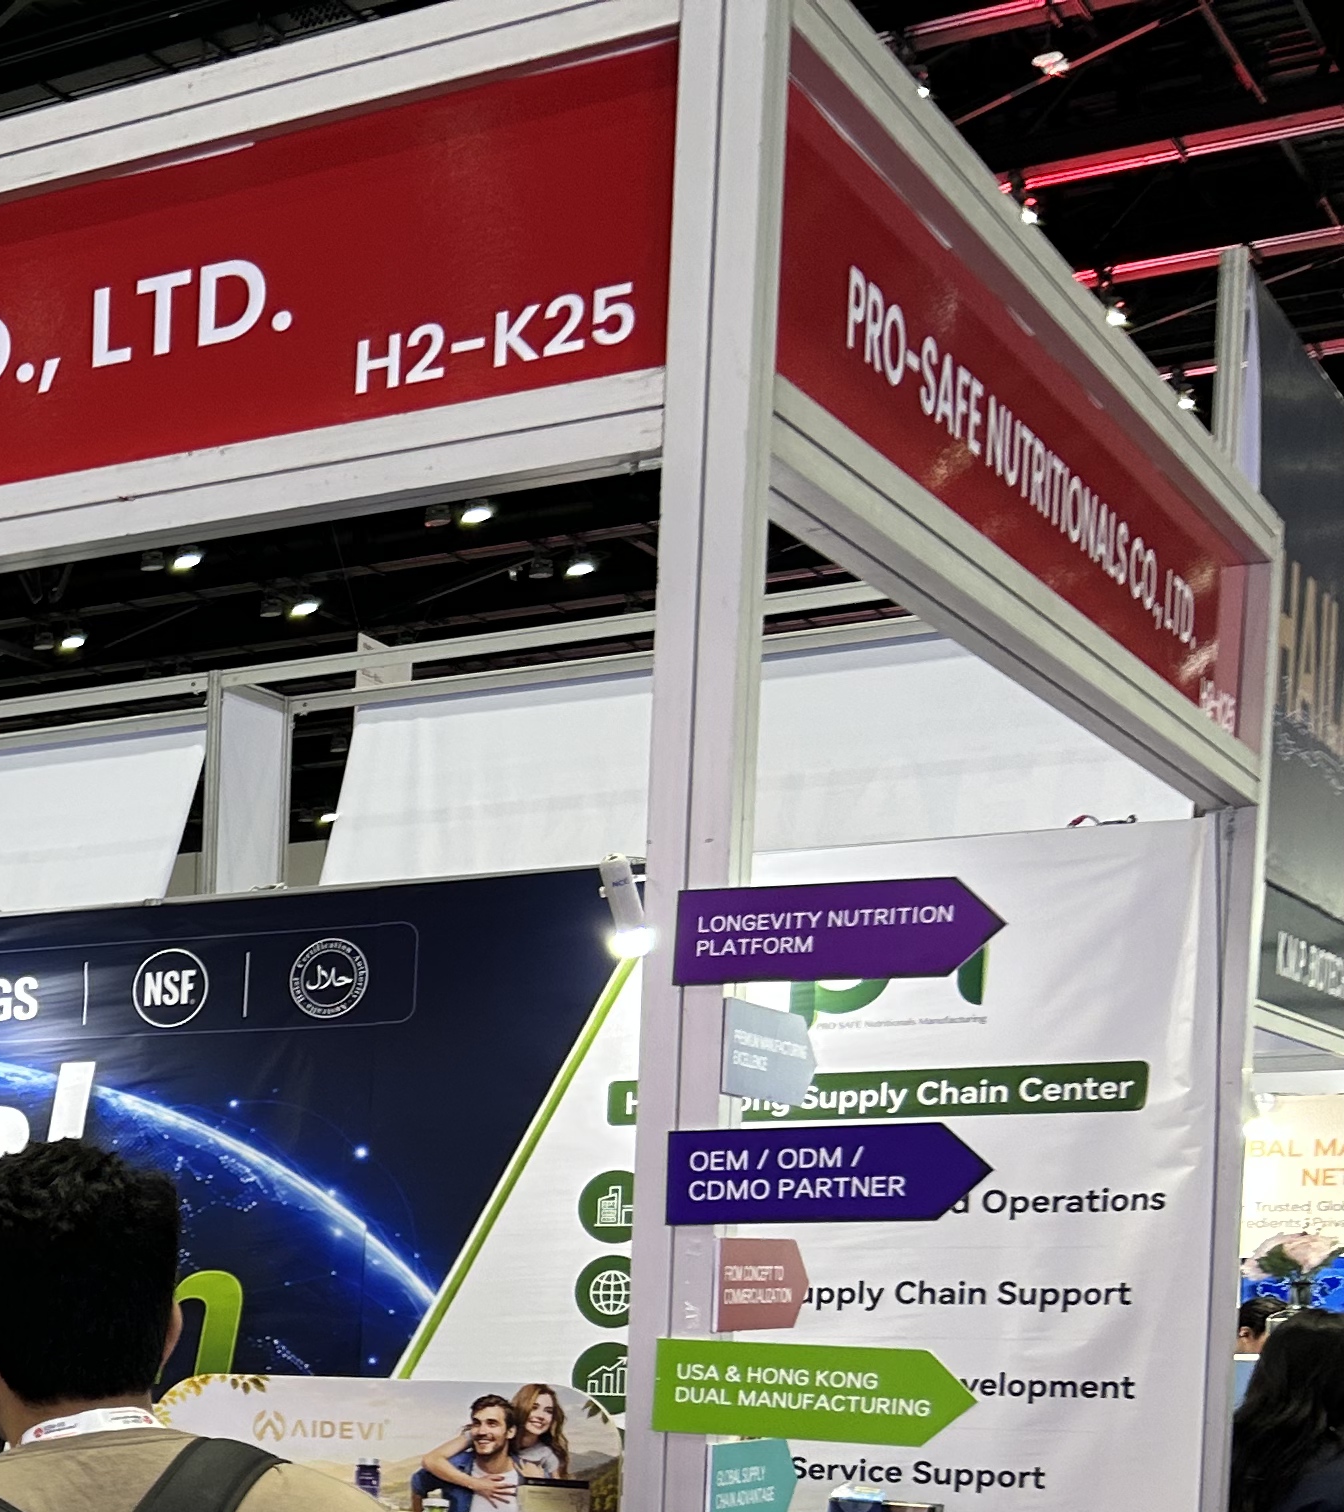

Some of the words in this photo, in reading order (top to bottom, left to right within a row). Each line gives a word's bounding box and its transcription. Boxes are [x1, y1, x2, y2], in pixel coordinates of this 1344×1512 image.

[92, 259, 293, 369] LTD.
[354, 281, 636, 395] H2-K25
[846, 265, 983, 458] PRO-SAFE
[986, 394, 1128, 586] NUTRITIONALS
[696, 911, 824, 934] LONGEVITY
[827, 905, 955, 928] NUTRITION
[695, 936, 814, 958] PLATFORM
[143, 970, 197, 1007] NSF
[801, 1082, 907, 1114] Supply
[917, 1079, 1008, 1106] Chain
[1019, 1075, 1134, 1104] Center
[689, 1149, 749, 1172] OEM
[757, 1147, 770, 1172] /
[778, 1147, 845, 1169] ODM
[851, 1145, 864, 1170] /
[688, 1178, 771, 1202] CDMO
[778, 1176, 906, 1201] PARTNER
[981, 1187, 1166, 1221] Operations
[801, 1278, 884, 1312] upply
[894, 1280, 987, 1307] Chain
[997, 1280, 1132, 1313] Support
[676, 1363, 721, 1383] USA
[726, 1365, 741, 1383] &
[748, 1367, 810, 1387] HONG
[814, 1370, 879, 1391] KONG
[675, 1386, 732, 1406] DUAL
[737, 1389, 931, 1418] MANUFACTURING
[291, 1416, 387, 1442] AIDEVI
[792, 1457, 902, 1485] Service
[912, 1459, 1046, 1493] Support
